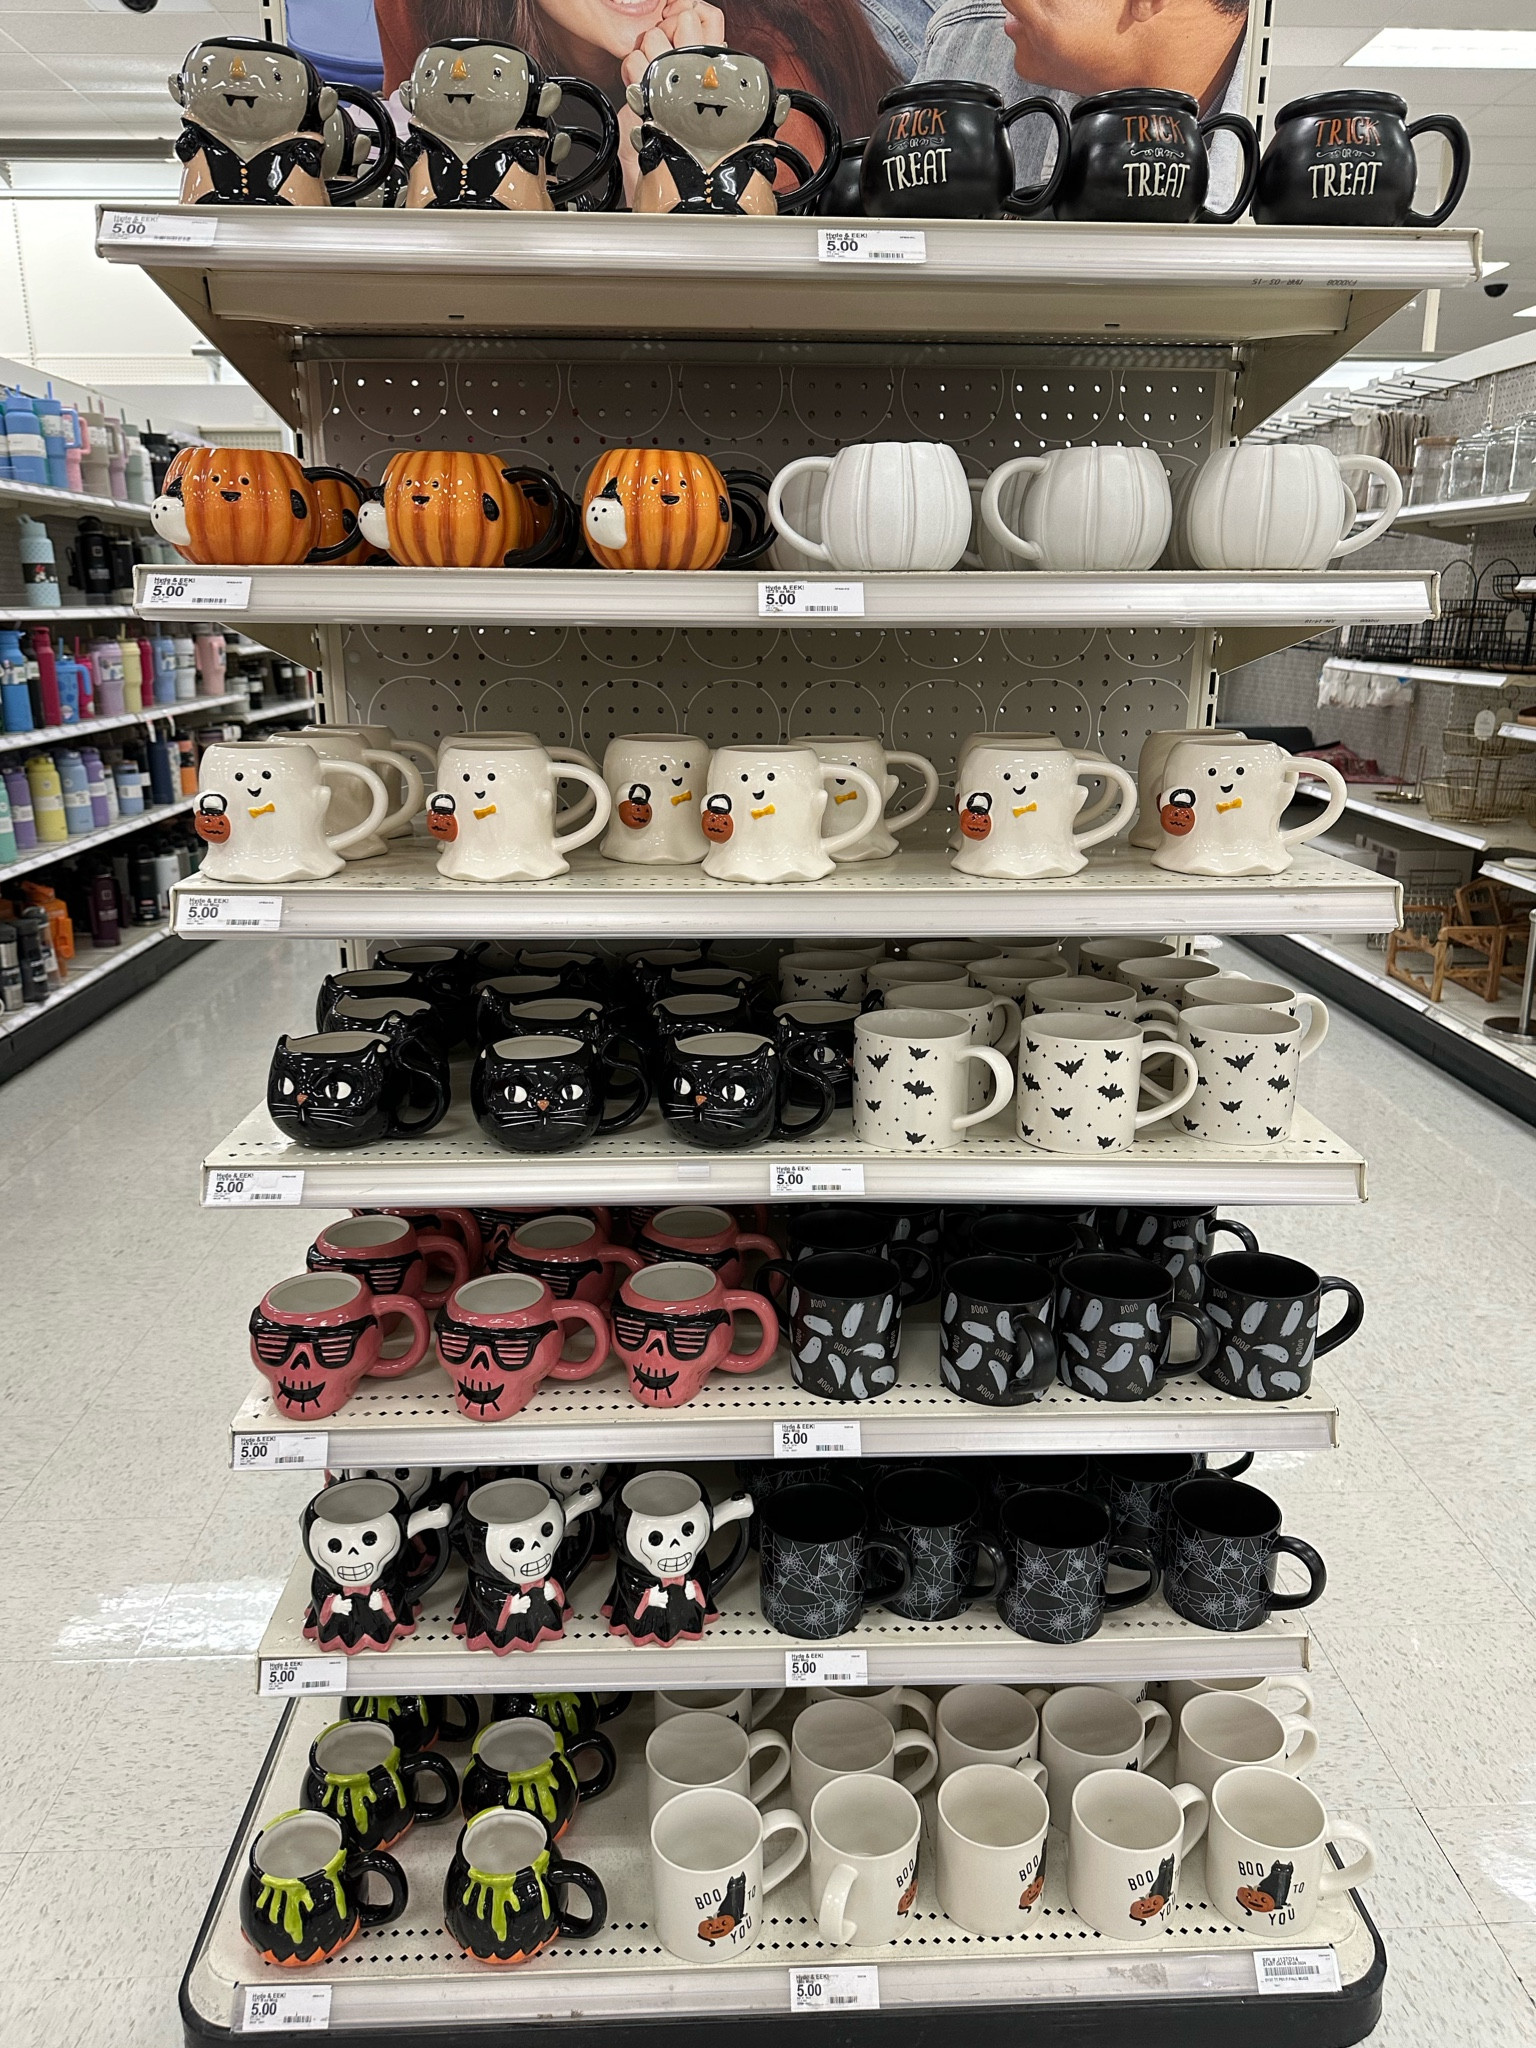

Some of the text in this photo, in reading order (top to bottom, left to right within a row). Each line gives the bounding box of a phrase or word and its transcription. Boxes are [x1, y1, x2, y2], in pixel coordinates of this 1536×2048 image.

[886, 108, 947, 142] TRICK
[1122, 114, 1185, 144] TRICK
[1314, 116, 1381, 147] TRICK
[910, 138, 918, 148] OR
[1155, 148, 1164, 158] OR
[1342, 148, 1351, 158] OR
[882, 148, 951, 192] TREAT
[1122, 162, 1190, 198] TREAT
[1308, 161, 1382, 199] TREAT
[112, 223, 146, 234] 5.00
[827, 240, 858, 251] 5.00
[152, 586, 184, 596] 5.00
[766, 594, 796, 604] 5.00
[188, 907, 218, 918] 5.00
[776, 1174, 803, 1184] 5.00
[215, 1182, 244, 1192] 5.00
[1212, 1288, 1228, 1299] BOOO
[810, 1299, 826, 1308] BOOO
[971, 1304, 988, 1314] BOOO
[1120, 1303, 1138, 1314] BOOO
[1232, 1336, 1250, 1352] BOOO
[817, 1378, 834, 1394] BOOO
[976, 1384, 994, 1400] BOOO
[1126, 1382, 1144, 1395] BOOO
[782, 1432, 808, 1444] 5.00
[241, 1446, 268, 1458] 5.00
[792, 1662, 816, 1673] 5.00
[270, 1670, 294, 1682] 5.00
[896, 1859, 914, 1888] BOO
[1019, 1855, 1039, 1882] BOO
[1128, 1870, 1154, 1890] BOO
[1238, 1860, 1305, 1893] BOO TO
[695, 1885, 756, 1910] BOO TO
[1160, 1893, 1175, 1921] YOU
[1269, 1908, 1295, 1926] YOU
[730, 1916, 752, 1944] YOU
[797, 1984, 822, 1996] 5.00
[251, 2002, 277, 2015] 5.00
